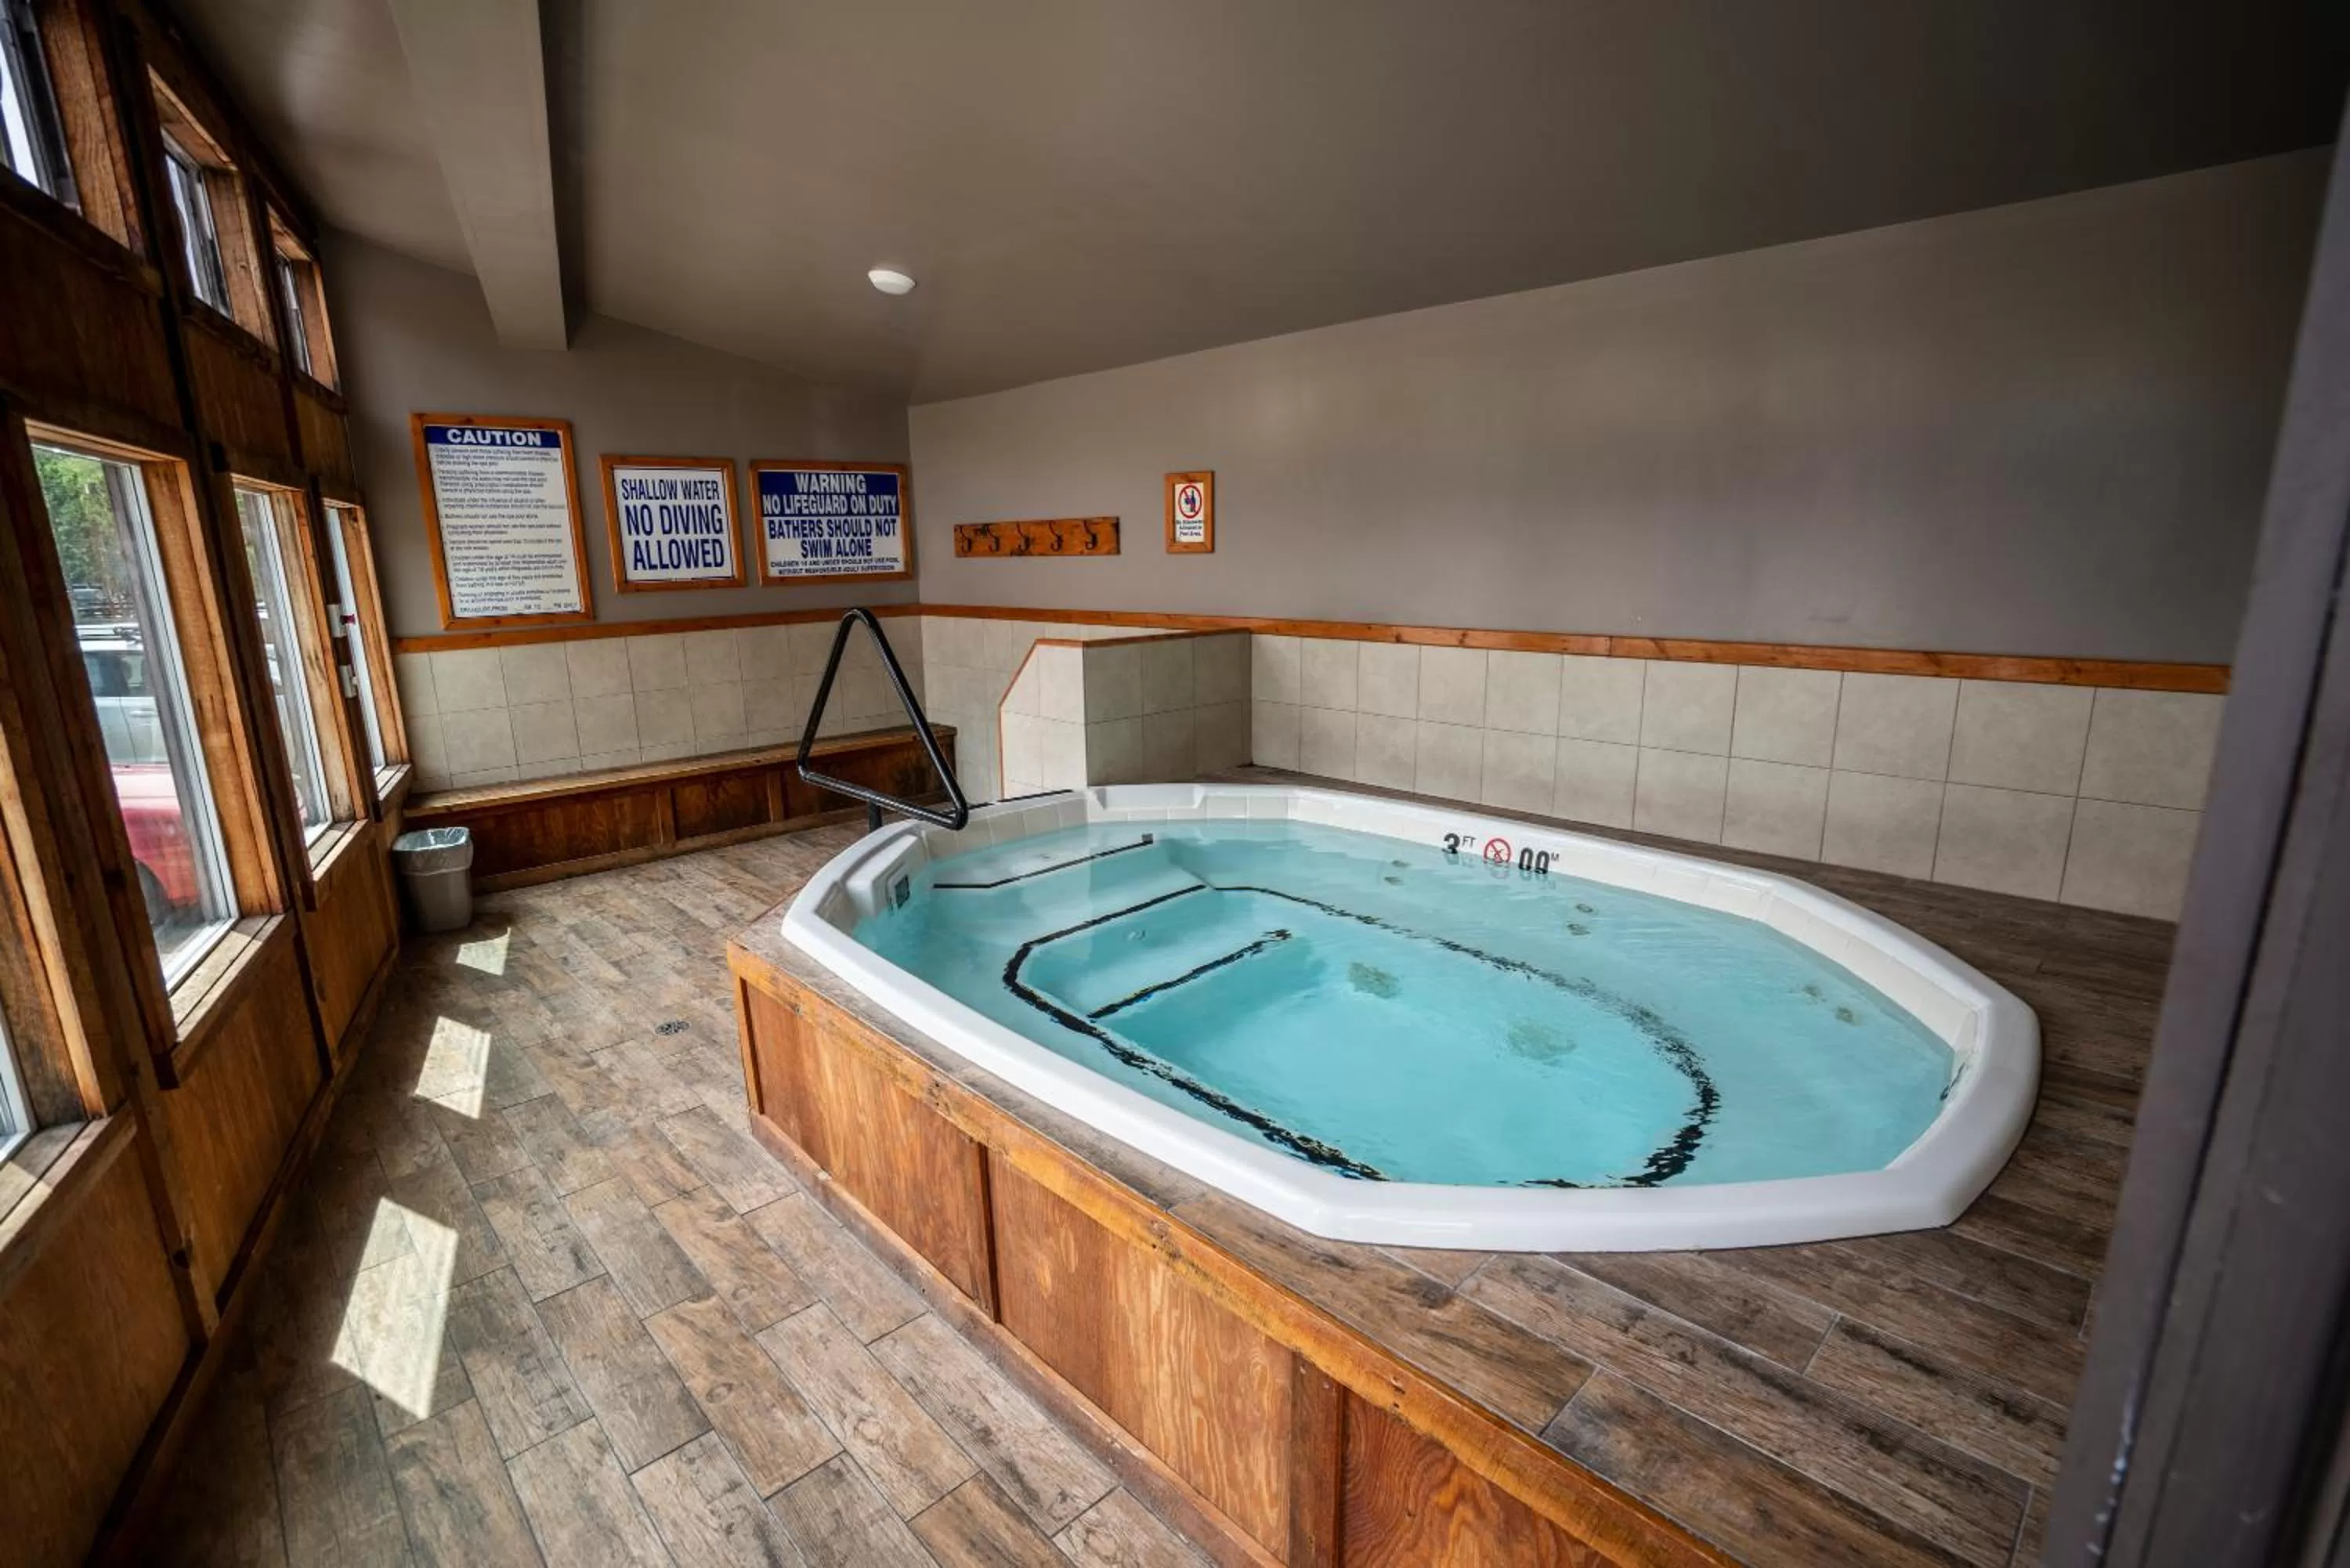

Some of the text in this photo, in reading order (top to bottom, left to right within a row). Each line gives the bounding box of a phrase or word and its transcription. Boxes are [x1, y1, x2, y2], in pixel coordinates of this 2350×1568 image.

[447, 428, 541, 446] CAUTION
[621, 479, 720, 500] SHALLOW WATER
[794, 473, 867, 493] WARNING
[762, 494, 897, 515] NO LIFEGUARD ON DUTY
[624, 504, 724, 536] NO DIVING
[768, 518, 897, 539] BATHERS SHOULD NOT
[633, 538, 725, 571] ALLOWED
[801, 538, 873, 558] SWIM ALONE
[1441, 833, 1461, 854] 3
[1462, 836, 1476, 847] FT
[1551, 852, 1560, 862] M
